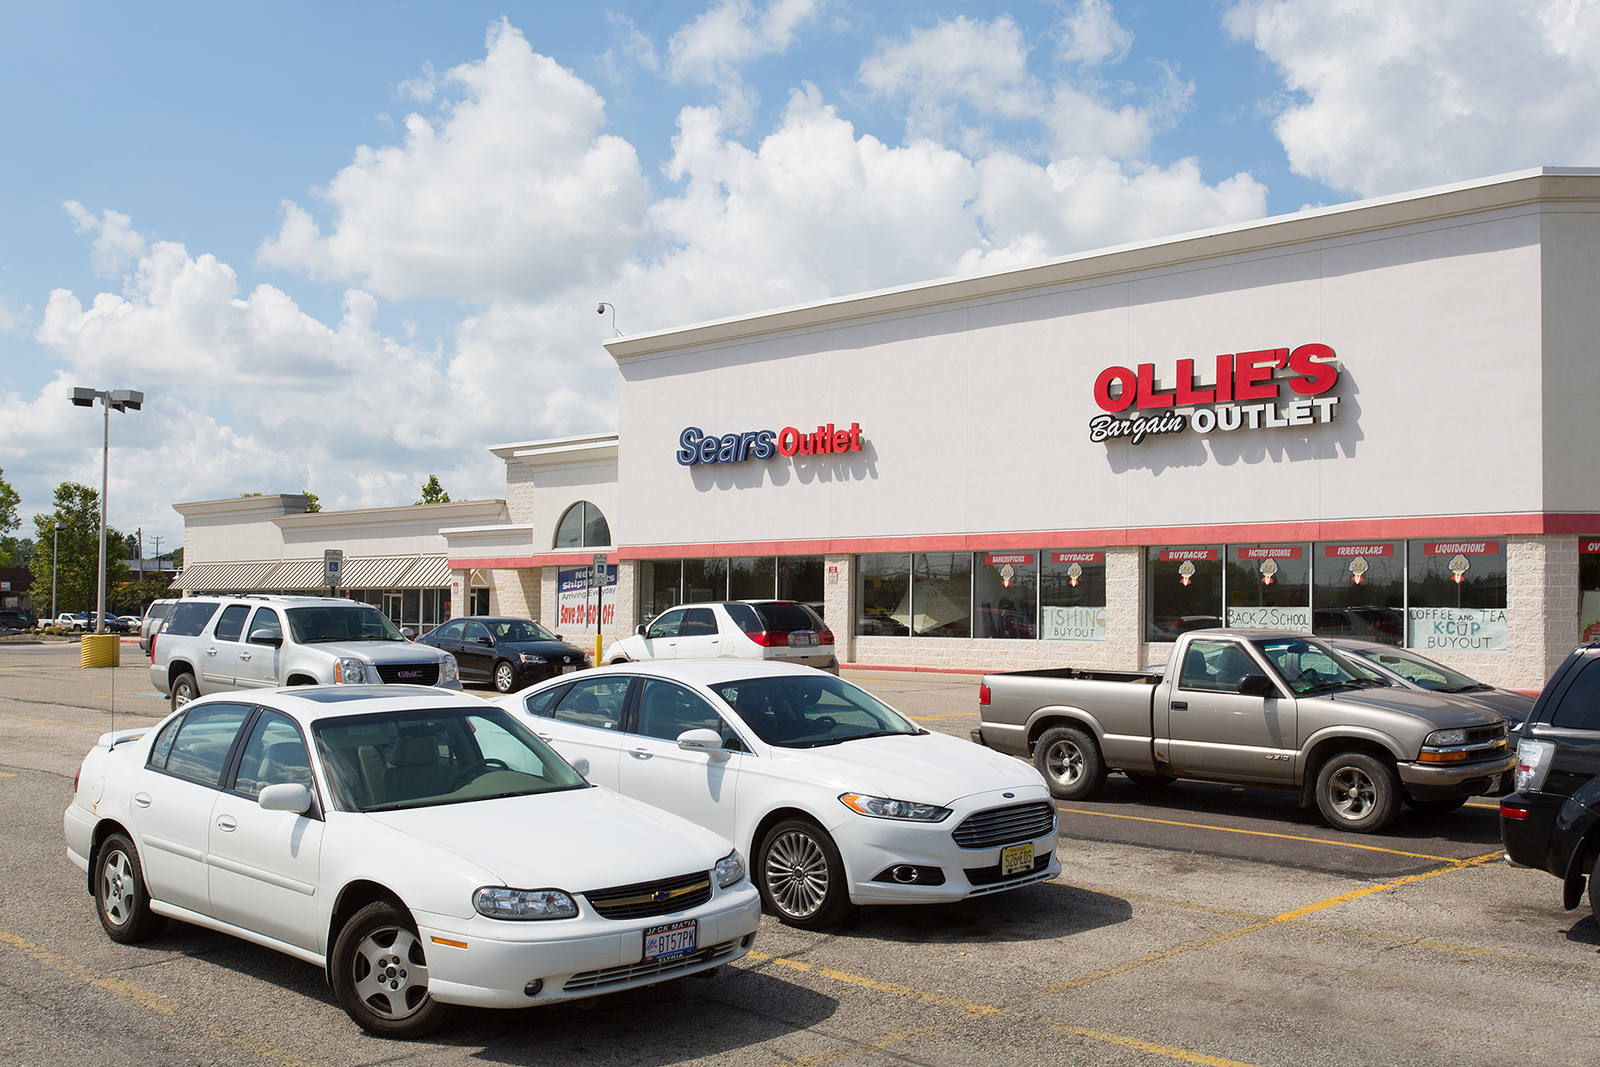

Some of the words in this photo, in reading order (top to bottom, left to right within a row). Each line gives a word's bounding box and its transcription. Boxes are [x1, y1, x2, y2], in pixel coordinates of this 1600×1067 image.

[1093, 343, 1338, 413] OLLIE'S
[1089, 411, 1186, 445] Bargain
[1191, 397, 1340, 434] OUTLET
[677, 426, 776, 466] Sears
[778, 422, 863, 457] Outlet
[1168, 550, 1208, 559] BUYBACKS
[1248, 549, 1268, 557] FACTORY
[1269, 548, 1291, 556] SECONDS
[1337, 545, 1383, 555] IRREGULARS
[1435, 543, 1485, 553] LIQUIDATIONS
[1059, 553, 1095, 561] BUYBACKS
[562, 591, 586, 600] Arriving
[588, 587, 616, 598] Eveyday
[560, 604, 576, 624] Save
[1228, 609, 1256, 625] BACK
[1259, 608, 1268, 625] 2
[1270, 608, 1309, 626] SCHOOL
[1410, 609, 1454, 621] COFFEE
[1480, 610, 1507, 623] TEA
[1427, 636, 1492, 649] BUYOUT
[659, 930, 694, 953] BT57PK
